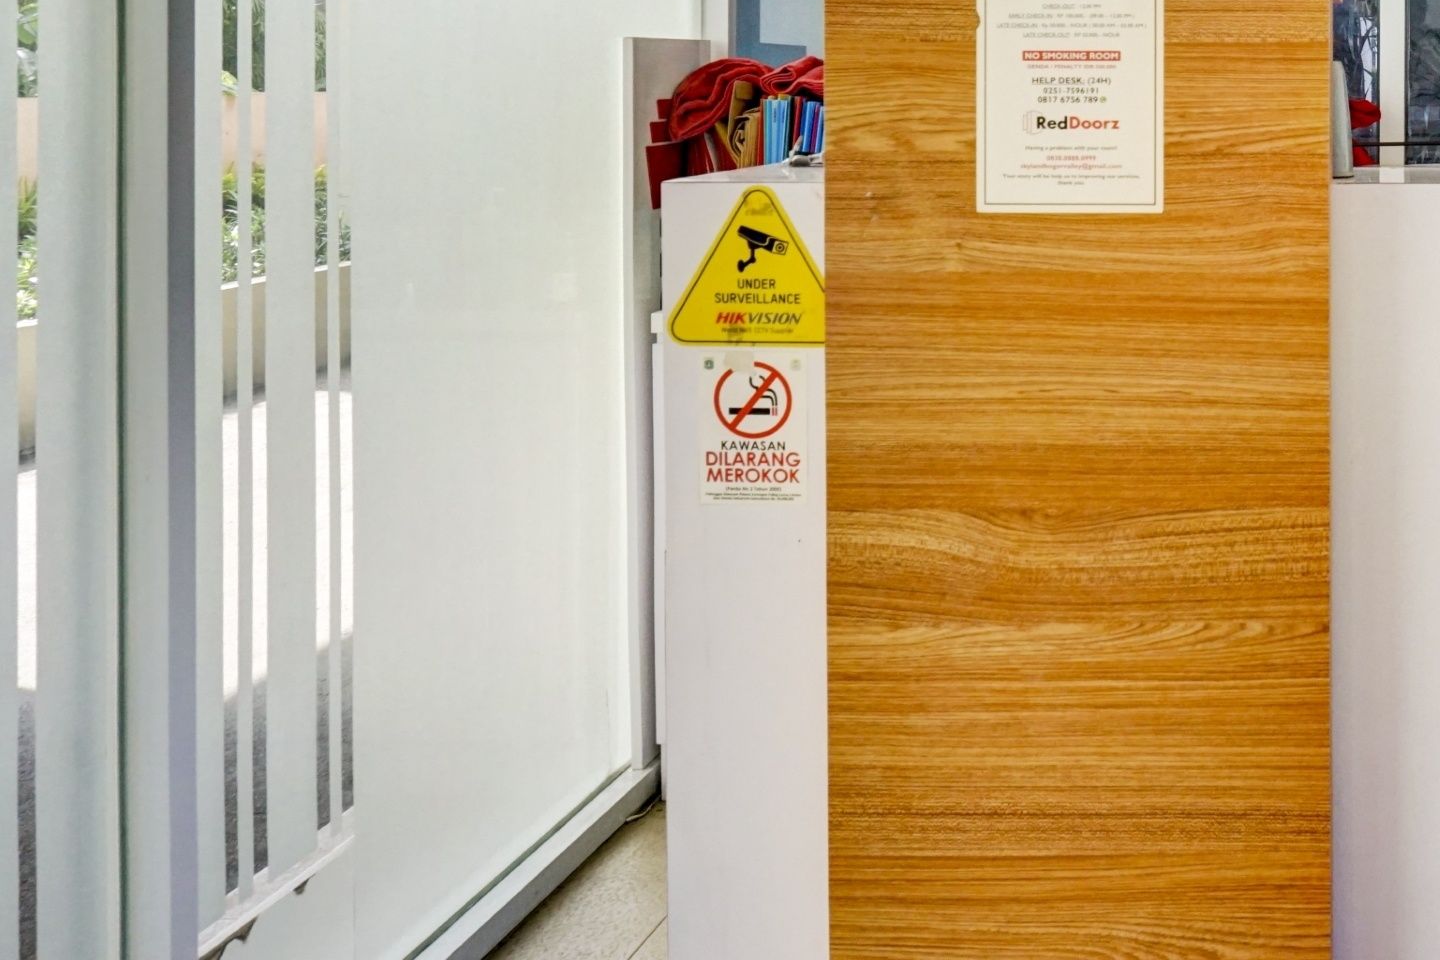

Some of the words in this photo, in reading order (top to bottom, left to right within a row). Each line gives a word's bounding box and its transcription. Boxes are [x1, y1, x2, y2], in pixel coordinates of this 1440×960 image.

[1025, 52, 1040, 60] NO
[1042, 52, 1087, 60] SMOKING
[1089, 52, 1119, 60] ROOM
[1031, 77, 1056, 85] HELP
[1087, 77, 1112, 85] (24H)
[1036, 116, 1120, 130] RedDoorz
[737, 278, 776, 289] UNDER
[715, 293, 801, 304] SURVEILLANCE
[716, 311, 802, 325] HIKVISION
[721, 440, 786, 451] KAWASAN
[705, 451, 801, 467] DILARANG
[706, 468, 800, 483] MEROKOK
